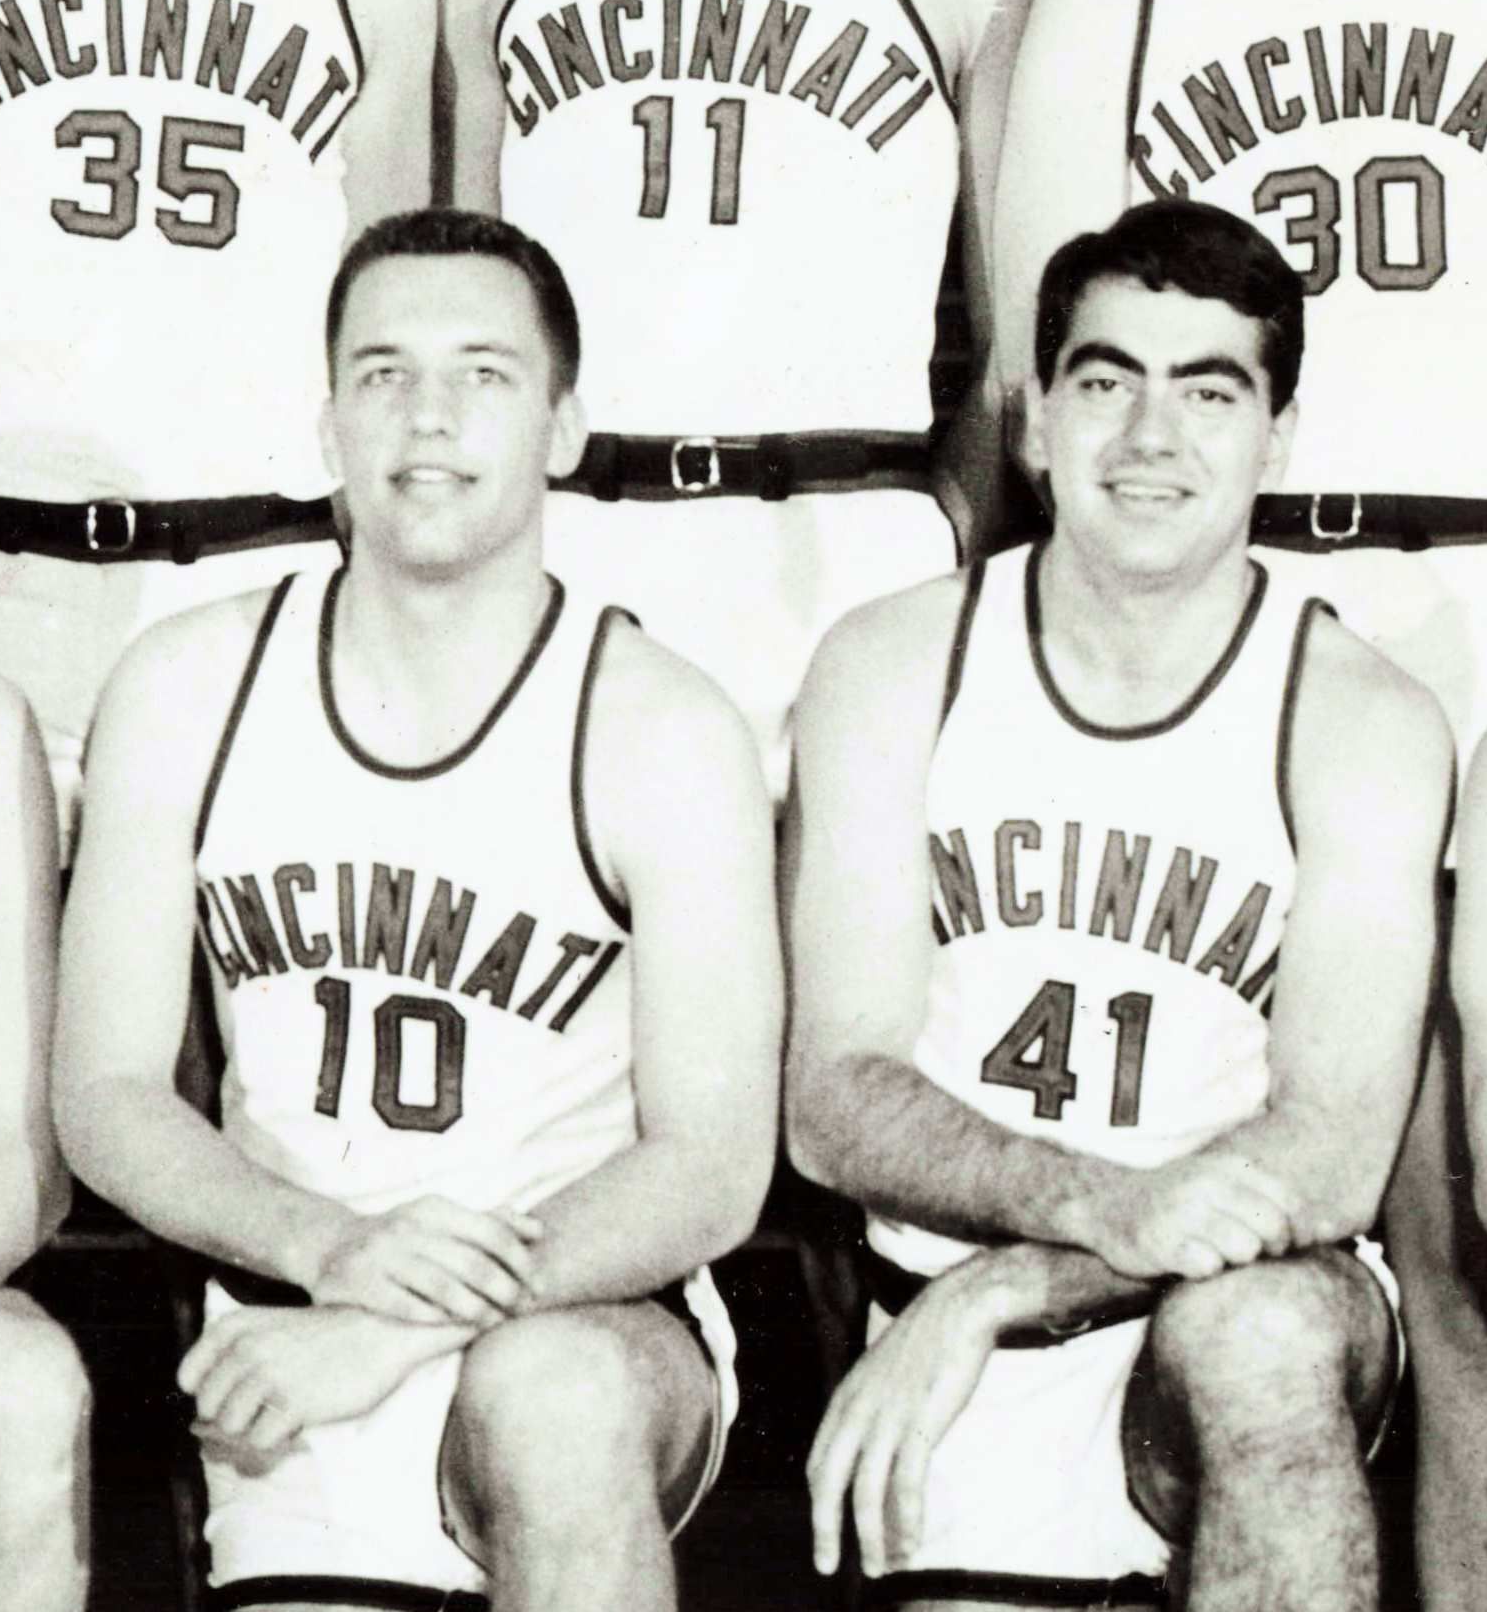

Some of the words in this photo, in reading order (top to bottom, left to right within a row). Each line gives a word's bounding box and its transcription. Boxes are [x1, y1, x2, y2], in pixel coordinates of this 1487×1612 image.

[51, 109, 245, 250] 35
[632, 94, 746, 225] 11
[1253, 155, 1448, 296] 30
[928, 819, 1279, 1020] NCINNA
[314, 976, 466, 1133] 10
[981, 979, 1153, 1126] 41
